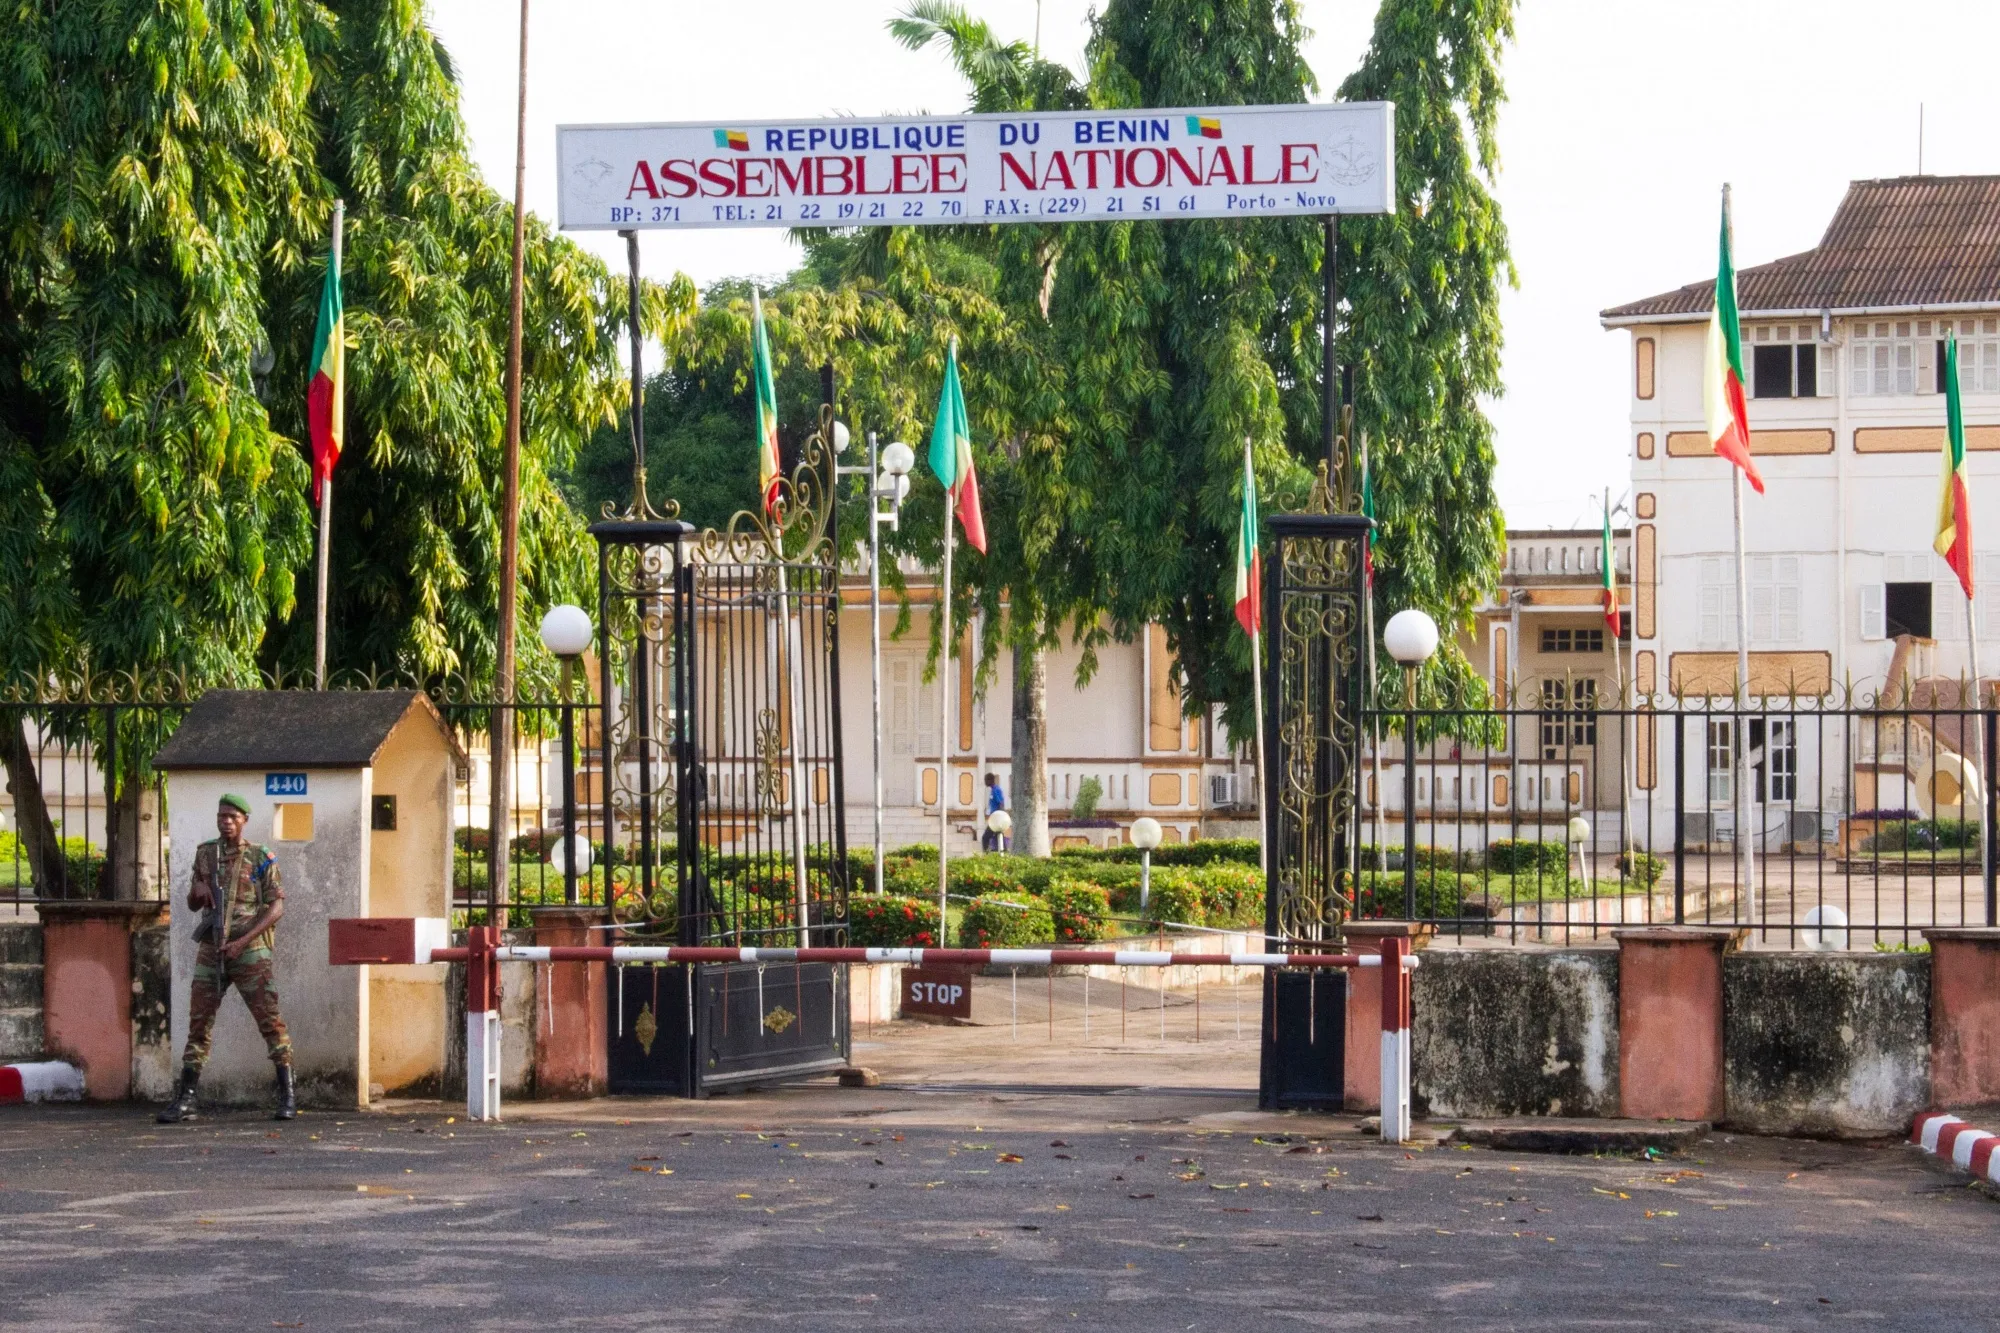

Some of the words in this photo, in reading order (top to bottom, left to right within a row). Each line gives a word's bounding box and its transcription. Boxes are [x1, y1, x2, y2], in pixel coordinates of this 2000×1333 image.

[765, 124, 966, 153] REPUBLIQUE
[999, 121, 1040, 147] DU
[1074, 118, 1170, 145] BENIN
[625, 152, 968, 201] ASSEMBLEE
[998, 142, 1320, 192] NATIONALE
[610, 205, 642, 223] BP:
[651, 206, 681, 222] 371
[712, 204, 756, 221] TEL:
[765, 204, 783, 220] 21
[800, 203, 821, 219] 22
[902, 201, 924, 217] 22
[941, 200, 962, 216] 70
[984, 198, 1030, 216] FAX:
[1038, 196, 1087, 216] (229)
[1106, 196, 1124, 213] 21
[1141, 195, 1161, 212] 51
[1178, 194, 1197, 211] 61
[267, 776, 306, 792] 440
[911, 981, 963, 1005] STOP
